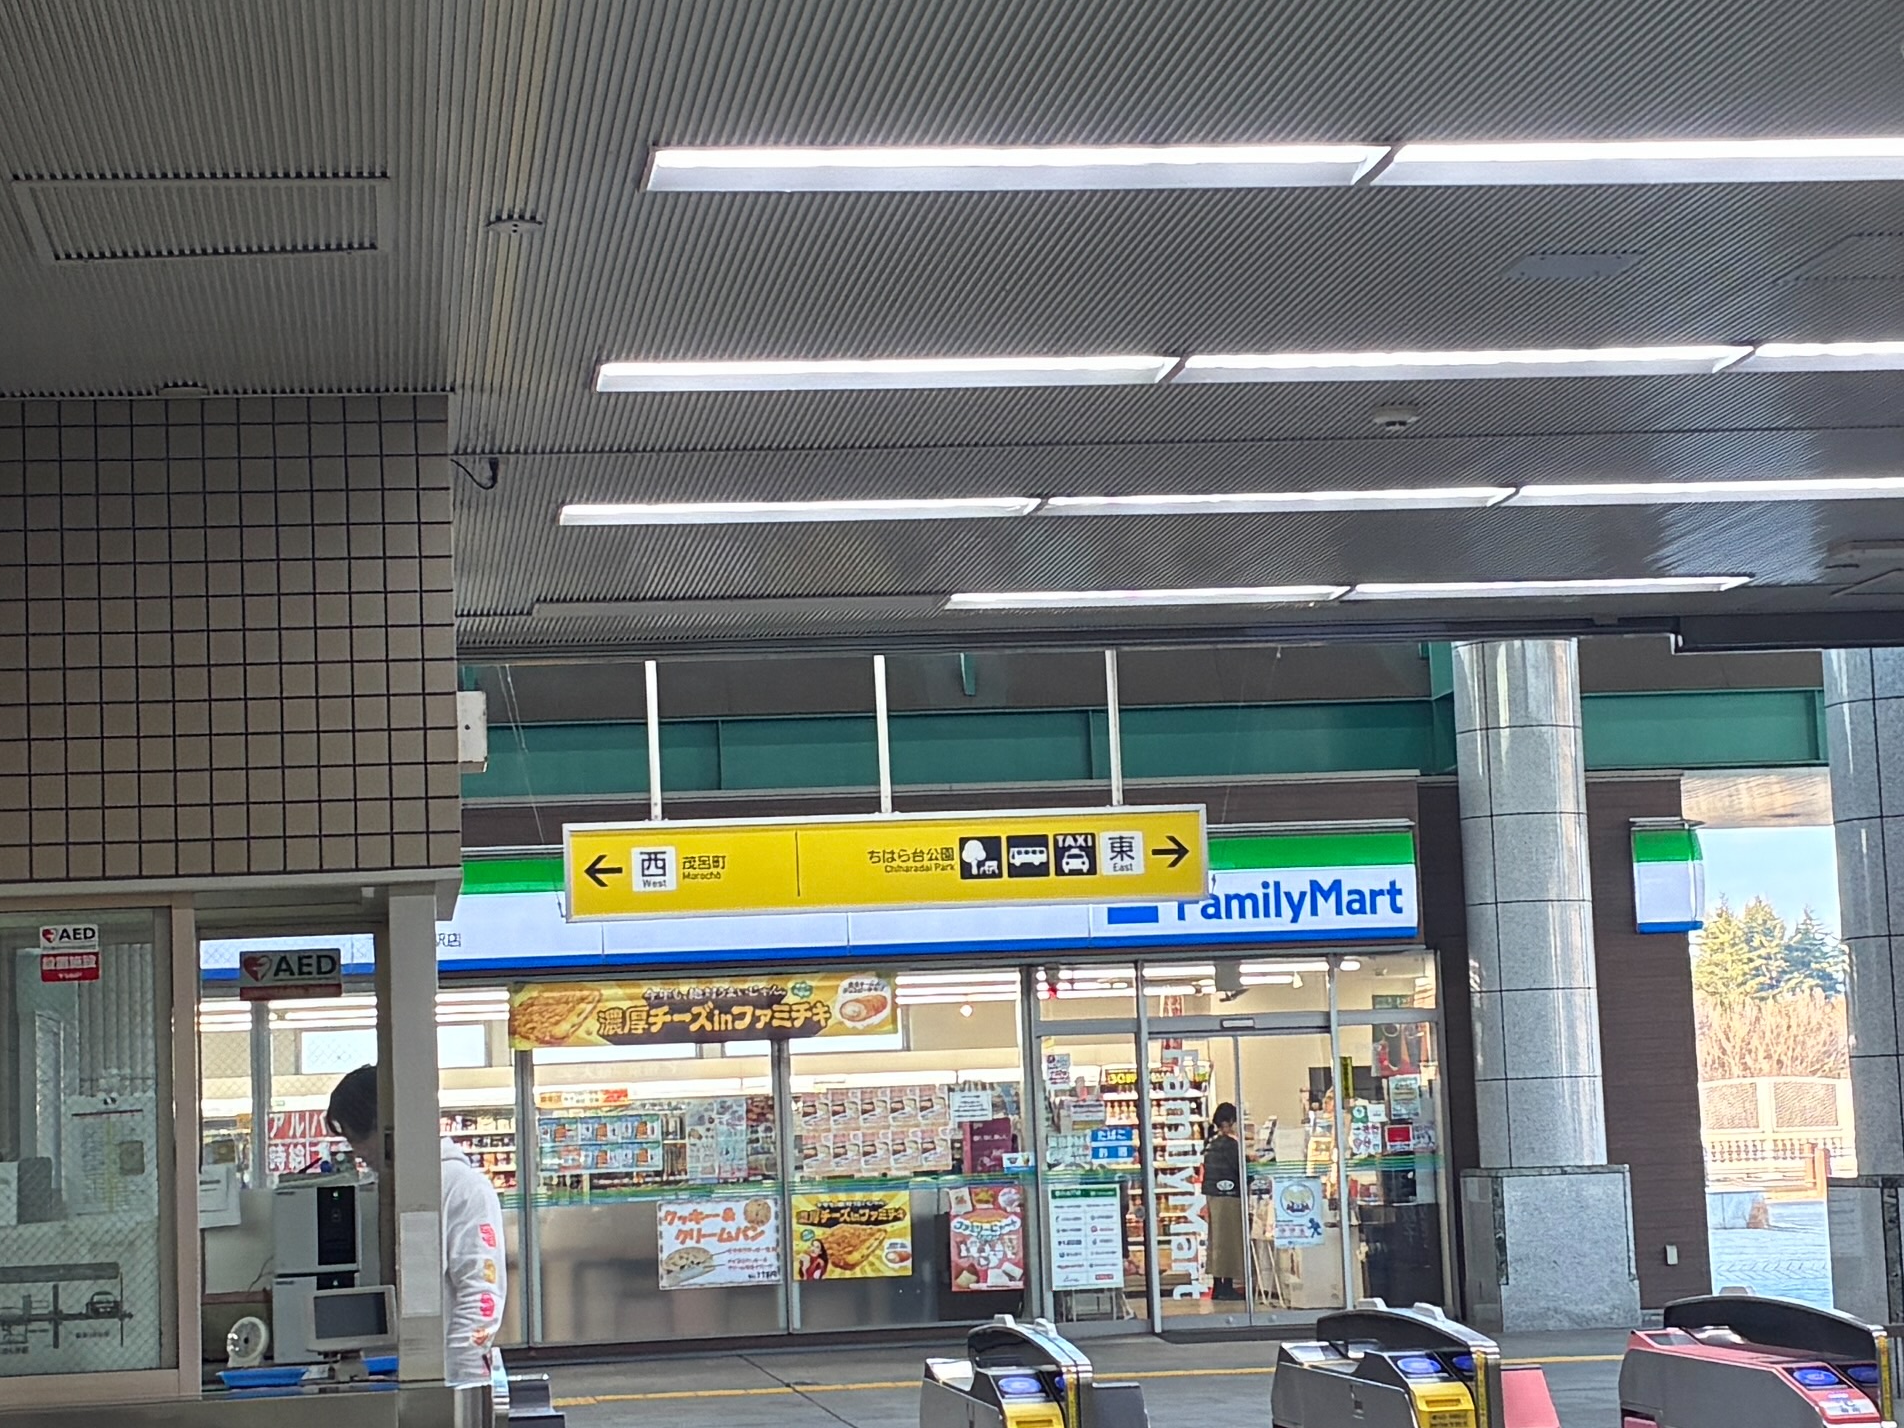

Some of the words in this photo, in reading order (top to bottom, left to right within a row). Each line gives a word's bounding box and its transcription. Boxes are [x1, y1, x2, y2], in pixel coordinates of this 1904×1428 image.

[1056, 834, 1093, 848] TAXI
[639, 851, 667, 878] 西
[682, 855, 727, 871] 茂呂町
[867, 847, 955, 864] ちはら台公園
[1108, 835, 1135, 862] 東
[642, 879, 667, 888] West
[933, 861, 956, 872] Park
[1112, 862, 1134, 872] East
[58, 926, 97, 941] AED
[272, 953, 338, 977] AED
[597, 1000, 833, 1036] 濃厚チーズinファミチキ
[1096, 1129, 1126, 1141] たばこ
[1161, 1048, 1211, 1300] FamilyMart
[674, 1223, 766, 1245] クリームパン
